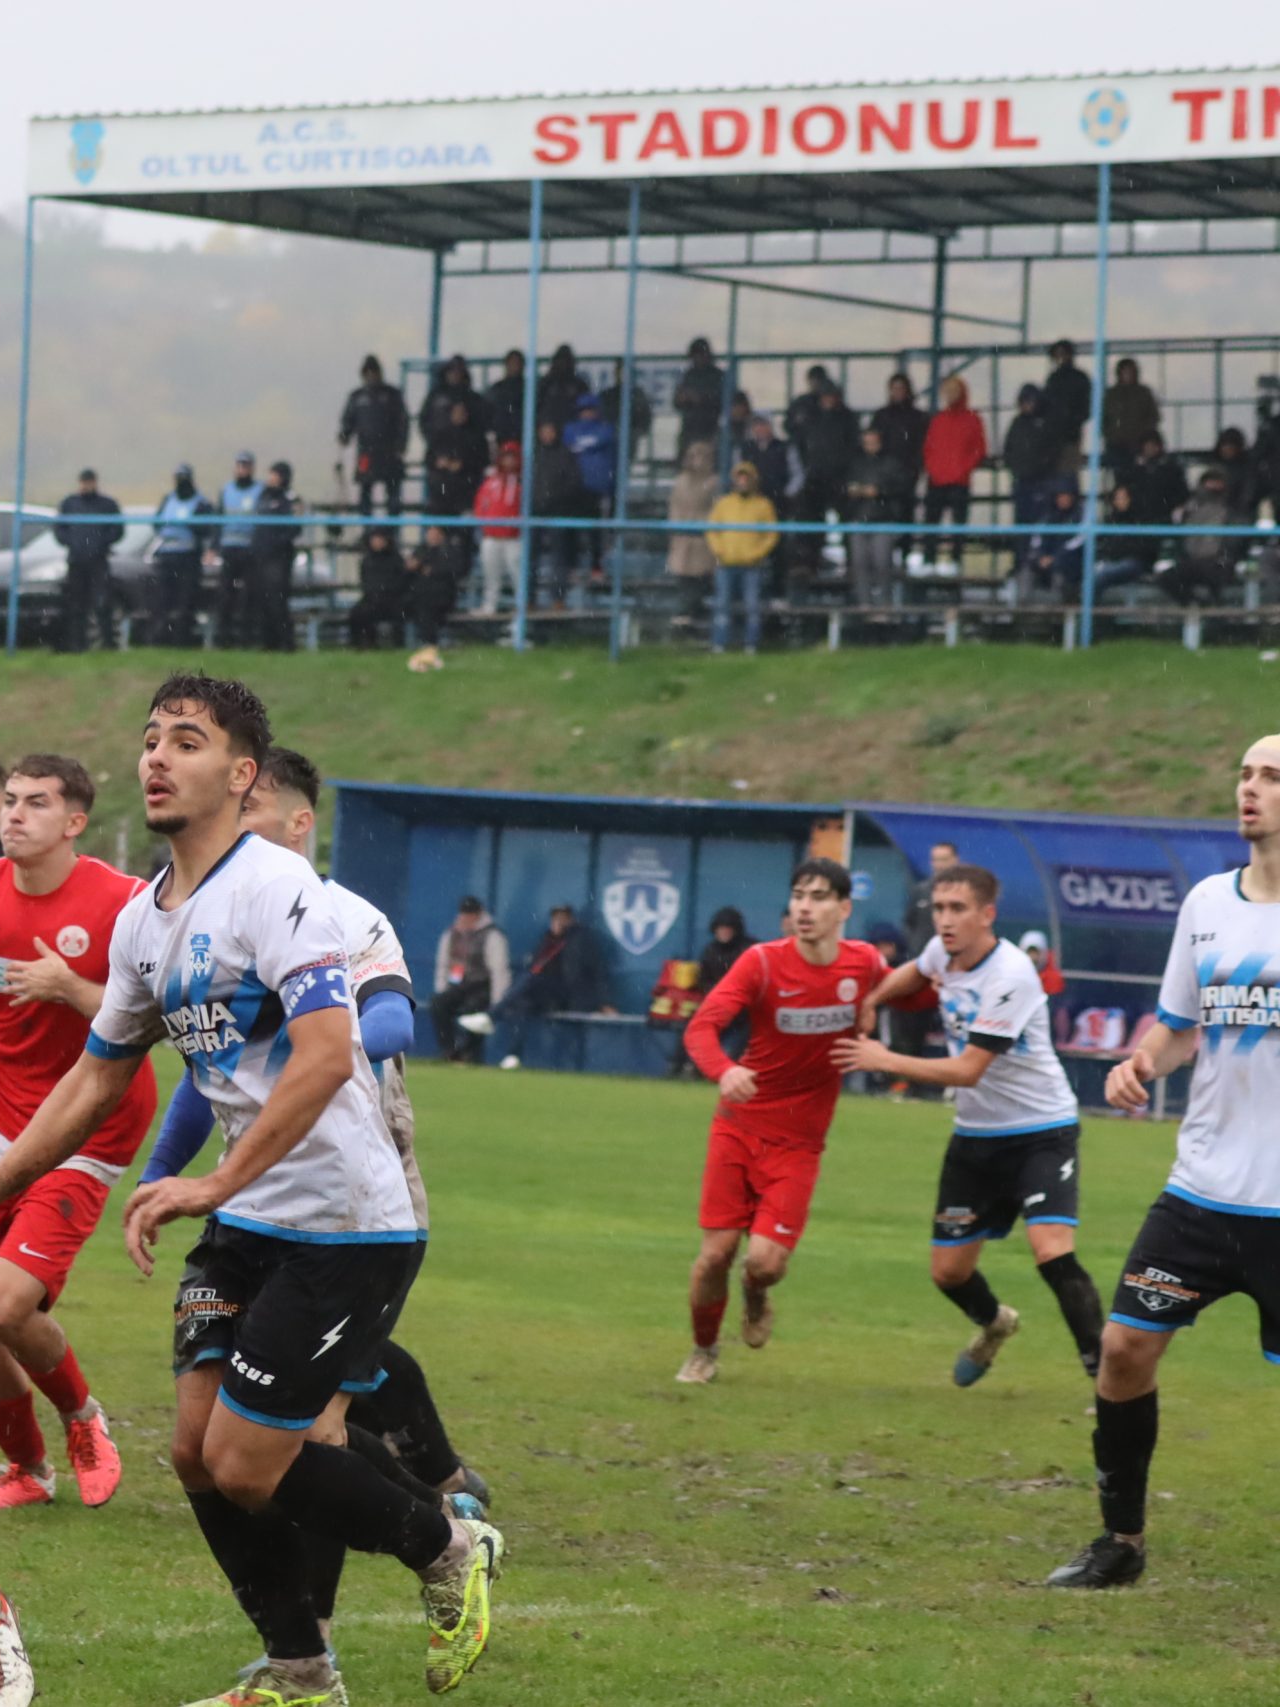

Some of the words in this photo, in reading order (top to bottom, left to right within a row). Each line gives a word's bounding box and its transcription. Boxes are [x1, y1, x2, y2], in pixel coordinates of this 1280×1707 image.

[258, 119, 356, 144] A.C.S.
[531, 97, 1039, 165] STADIONUL
[140, 153, 250, 178] OLTUL
[263, 143, 493, 175] CURTISOARA
[1058, 871, 1178, 912] GAZDE
[779, 1007, 856, 1029] REFDAN
[230, 1351, 275, 1386] Zeus
